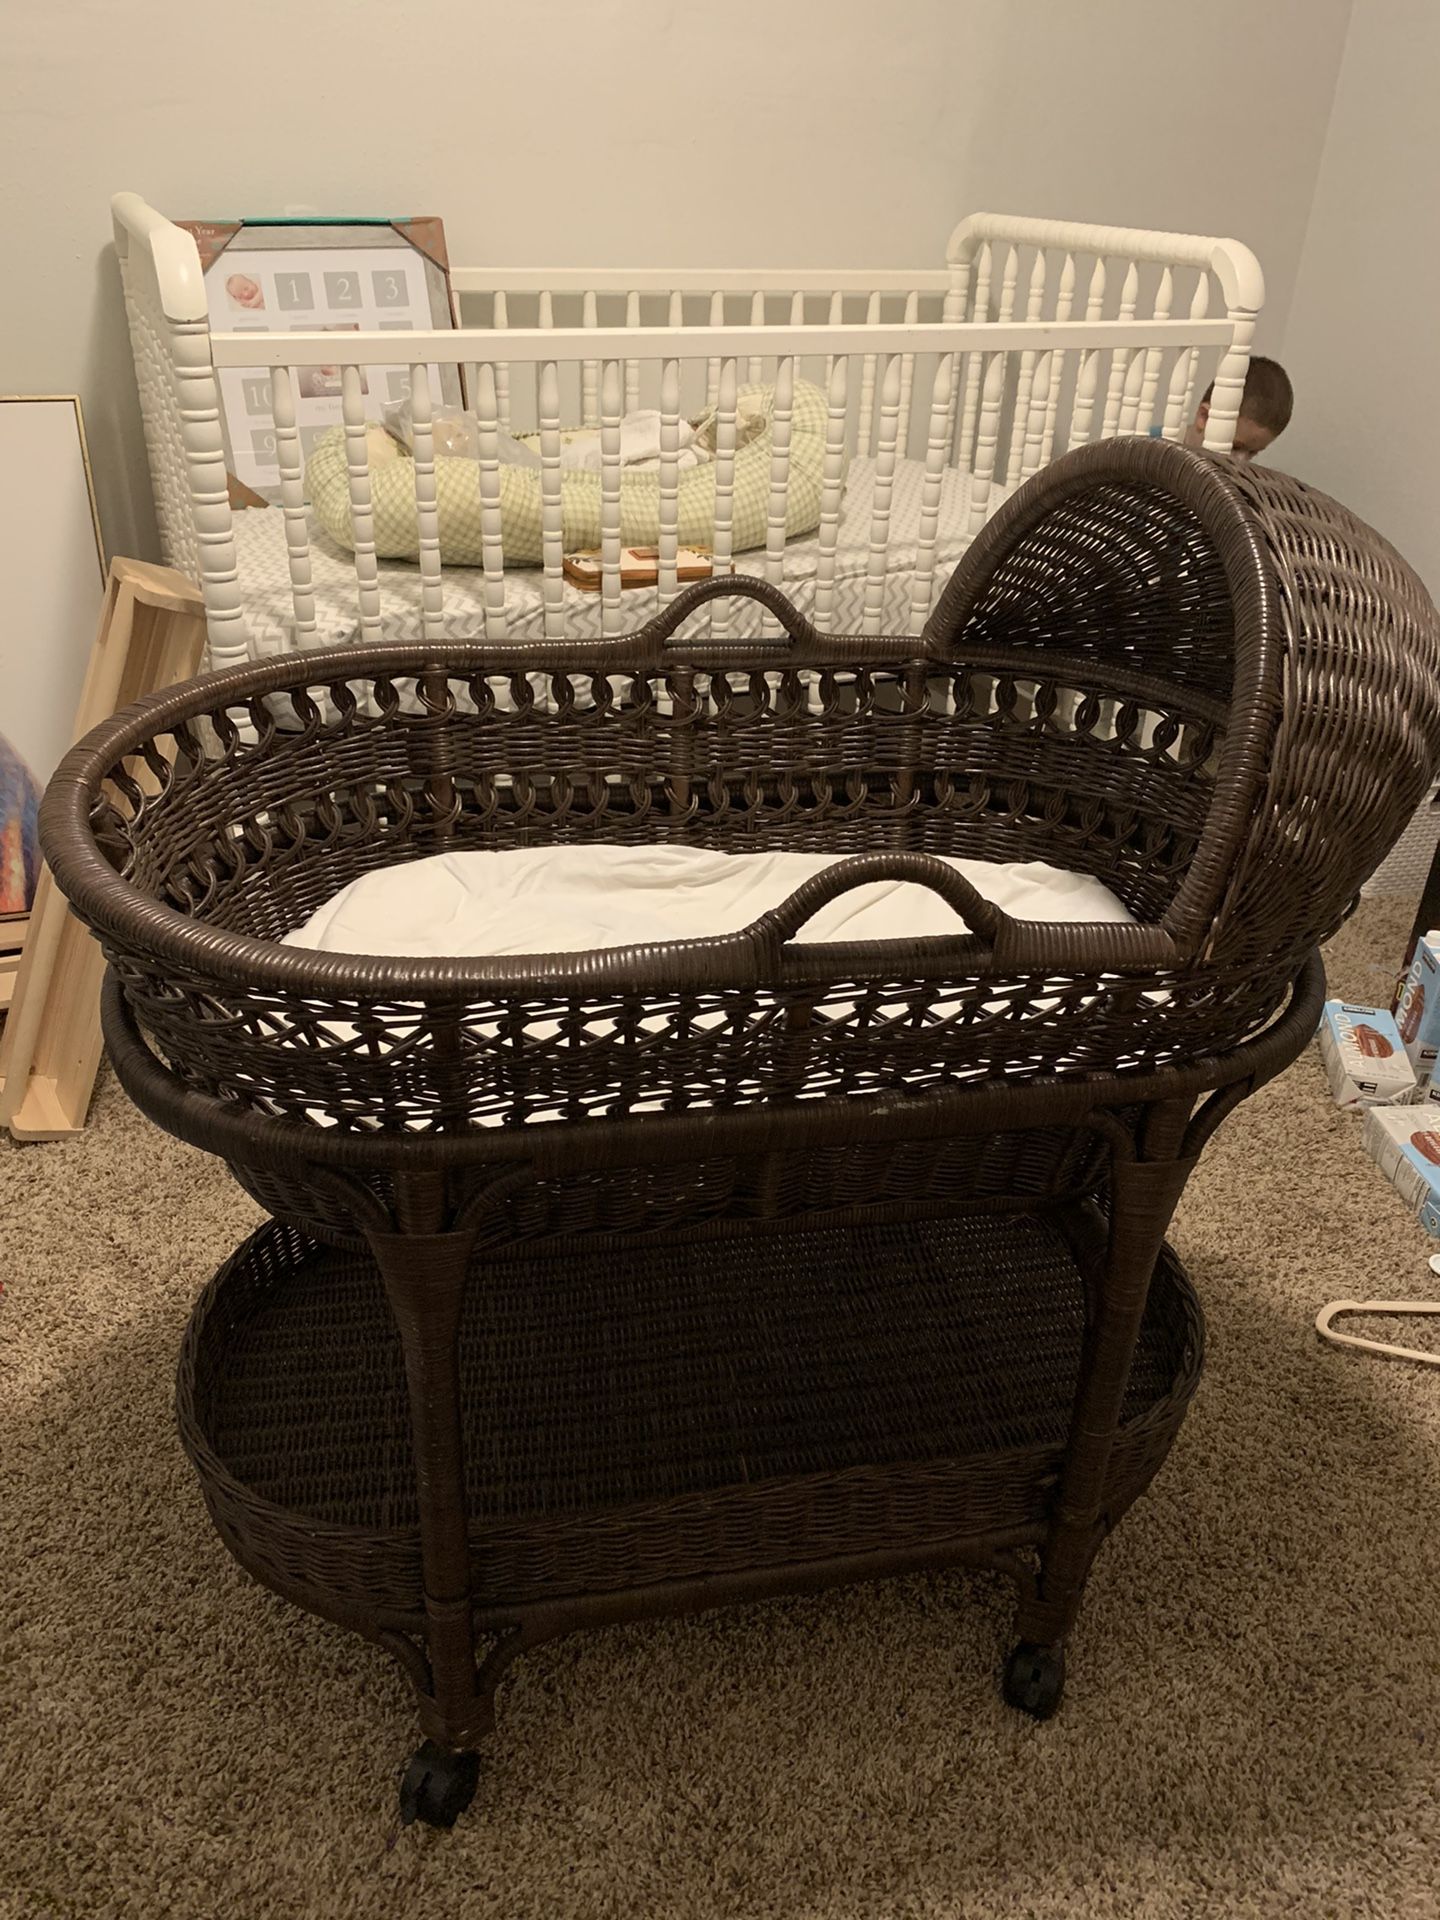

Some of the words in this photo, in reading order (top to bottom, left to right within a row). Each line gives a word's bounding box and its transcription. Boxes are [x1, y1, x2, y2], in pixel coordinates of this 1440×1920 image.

[287, 279, 300, 302] 1
[337, 278, 352, 301] 2
[385, 276, 399, 300] 3
[263, 434, 277, 457] 9
[1395, 960, 1422, 1030] MOND
